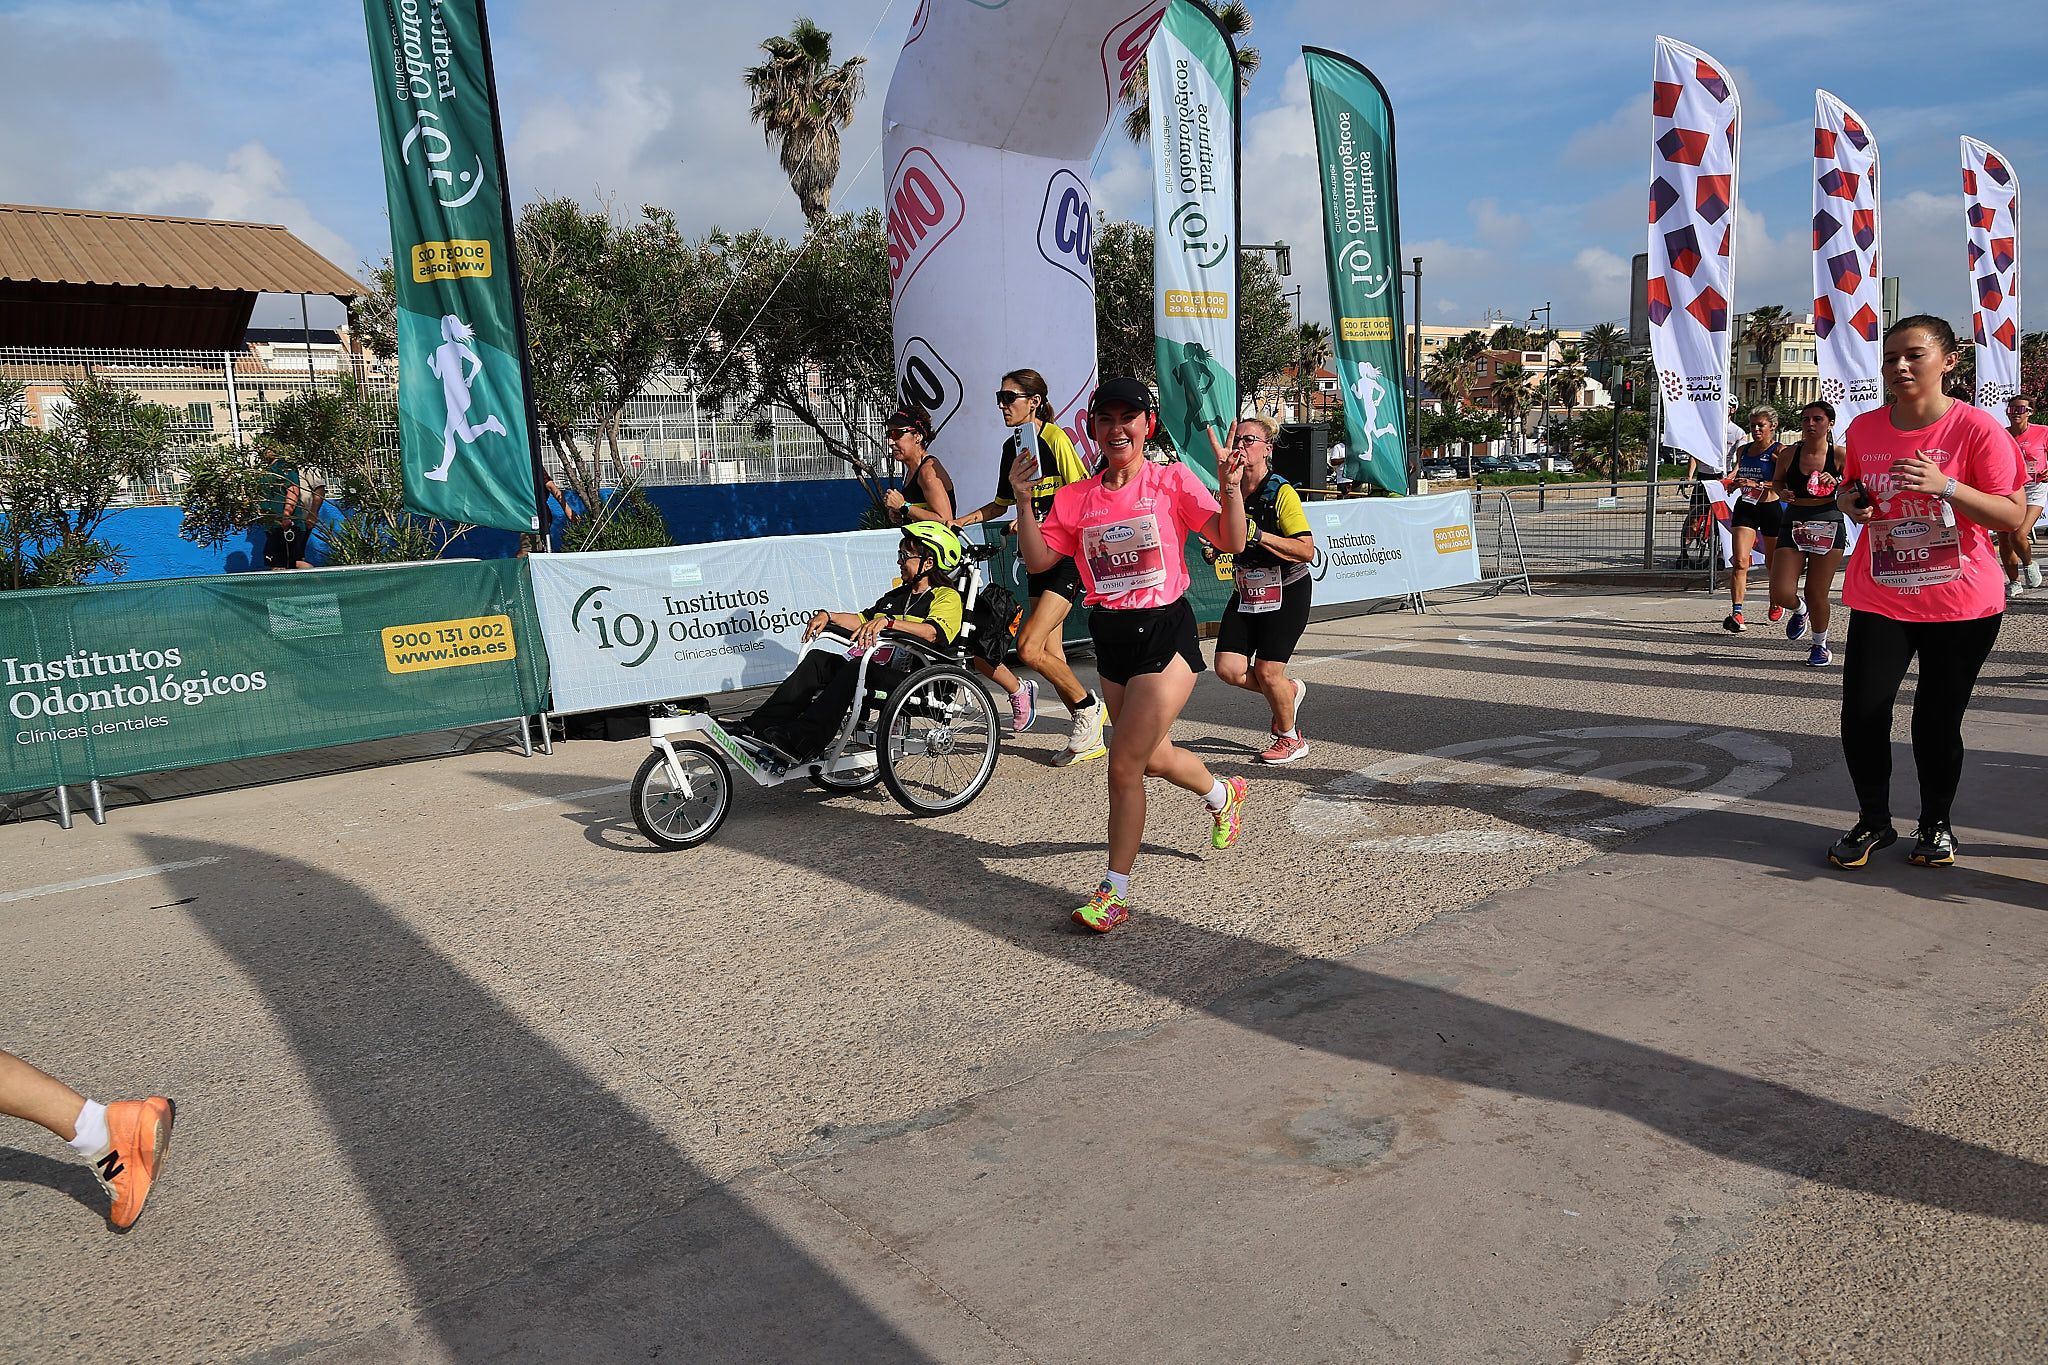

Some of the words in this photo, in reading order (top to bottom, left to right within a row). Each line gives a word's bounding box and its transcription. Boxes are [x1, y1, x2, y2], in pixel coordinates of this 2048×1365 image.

[1862, 453, 1892, 462] OYSHO
[1104, 530, 1133, 541] ASTURIANA
[1436, 532, 1447, 541] 900
[1456, 529, 1469, 538] 002
[1893, 527, 1927, 536] ASTURIANA
[1327, 532, 1377, 549] Institutos
[1111, 551, 1139, 566] 016
[1331, 548, 1402, 566] Odontológicos
[1896, 548, 1930, 562] 016
[1356, 568, 1377, 578] dentales
[1925, 573, 1952, 581] Santander
[1102, 581, 1124, 590] OYSHO
[1136, 576, 1158, 585] Santander
[1247, 588, 1266, 597] 016
[662, 589, 770, 616] Institutos
[392, 631, 432, 648] 900
[436, 628, 463, 643] 131
[468, 623, 505, 639] 002
[395, 641, 508, 664] www.ioa.es
[674, 647, 718, 662] Clínicas
[718, 641, 765, 656] dentales
[2, 647, 182, 686] Institutos
[9, 669, 267, 720] Odontológicos
[16, 725, 88, 745] Clínicas
[91, 715, 169, 736] dentales
[711, 723, 758, 774] PEDALNET
[97, 1149, 125, 1182] N
